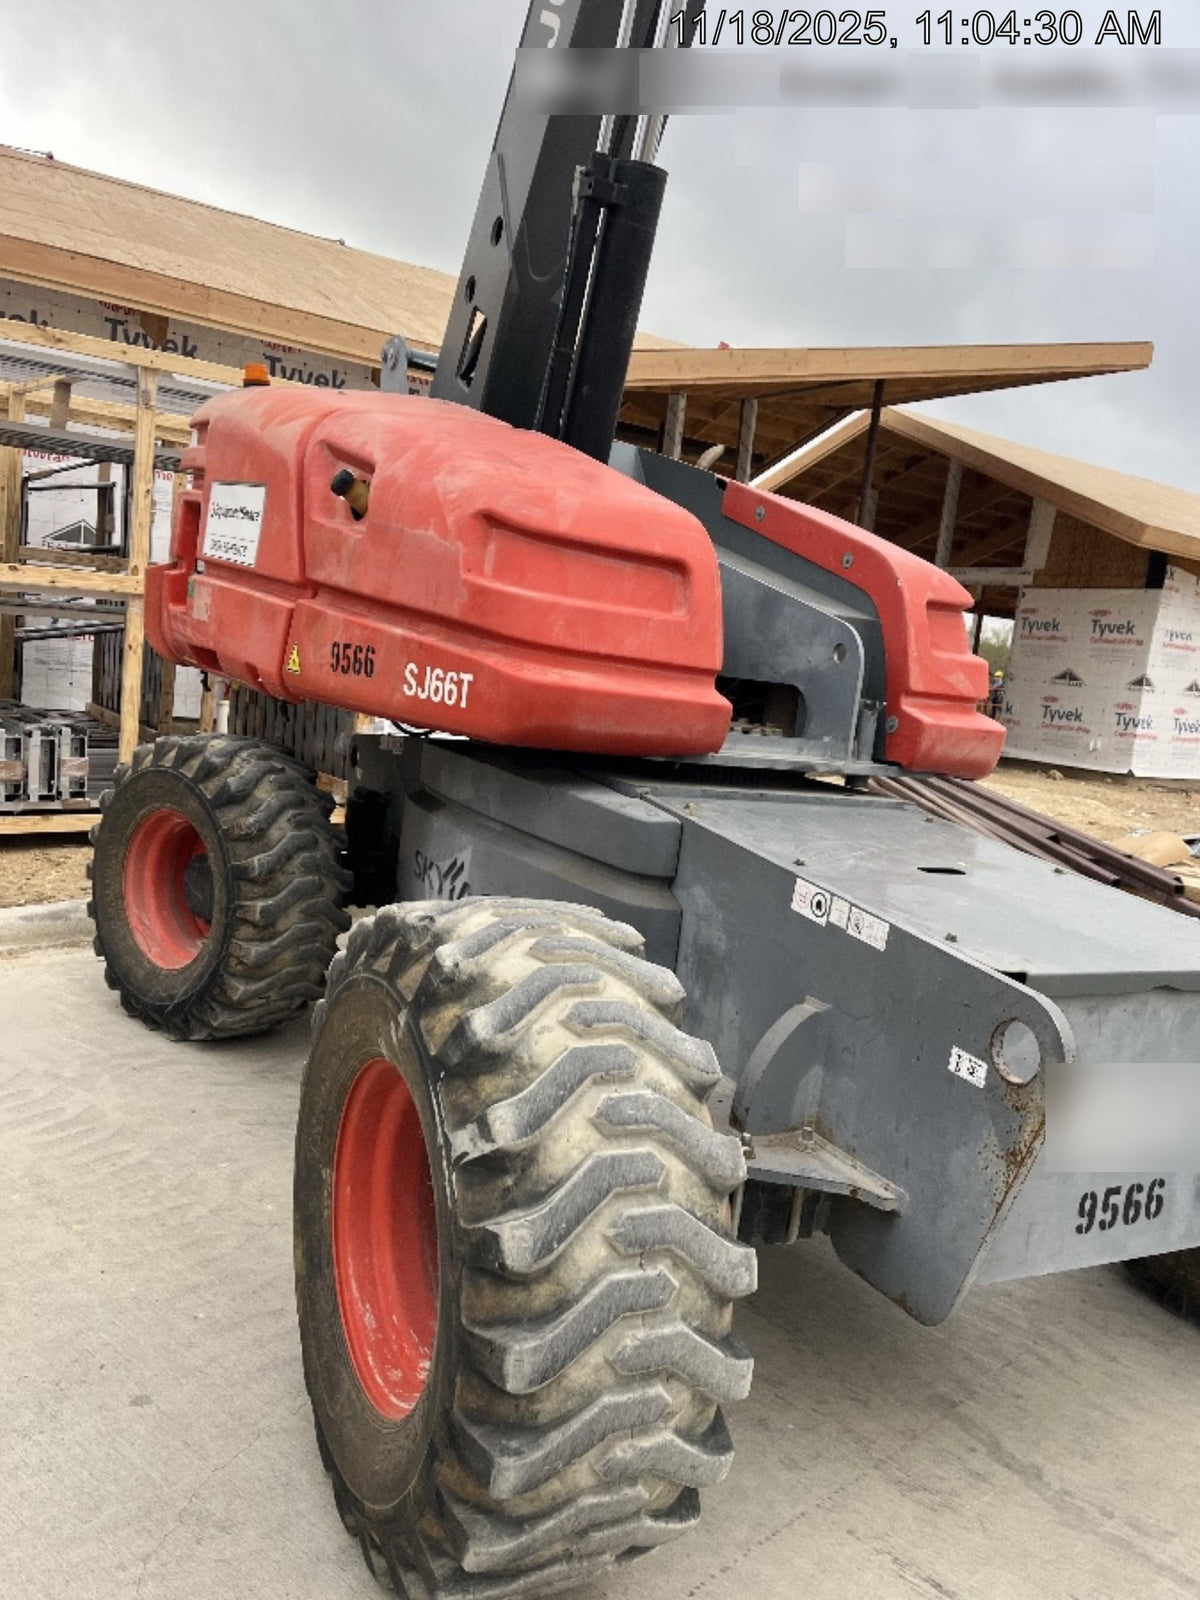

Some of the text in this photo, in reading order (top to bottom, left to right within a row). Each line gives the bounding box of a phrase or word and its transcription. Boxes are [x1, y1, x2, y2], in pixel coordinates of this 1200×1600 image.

[1021, 616, 1060, 634] Tyvek
[1091, 618, 1136, 637] Tyvek
[330, 641, 376, 678] 9566
[403, 662, 474, 709] SJ66T
[1040, 703, 1083, 722] Tyvek
[1075, 1177, 1166, 1235] 9566
